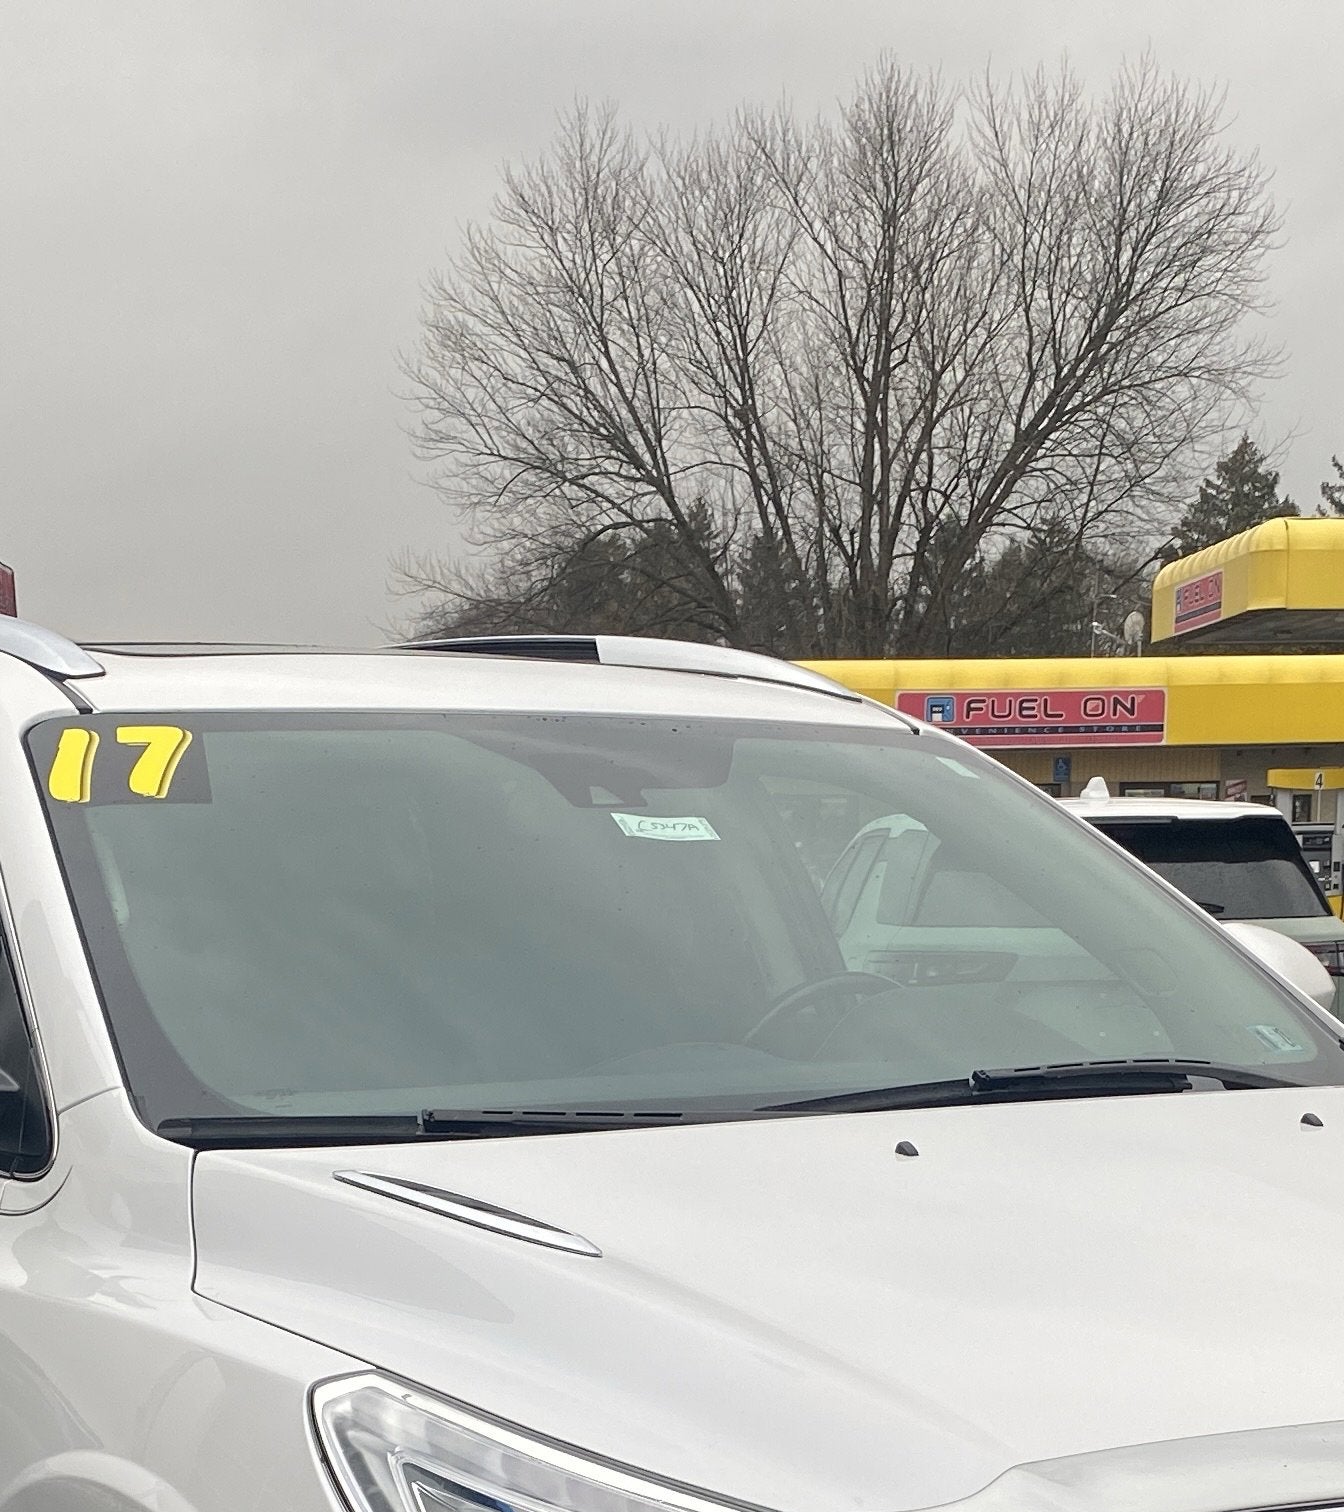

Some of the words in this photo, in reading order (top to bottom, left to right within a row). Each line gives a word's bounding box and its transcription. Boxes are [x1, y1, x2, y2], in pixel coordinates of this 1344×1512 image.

[1183, 582, 1206, 605] FUEL
[965, 697, 1065, 719] FUEL
[1084, 695, 1136, 718] ON
[1079, 725, 1142, 733] STORE
[49, 726, 193, 803] 17
[1315, 773, 1324, 788] 4
